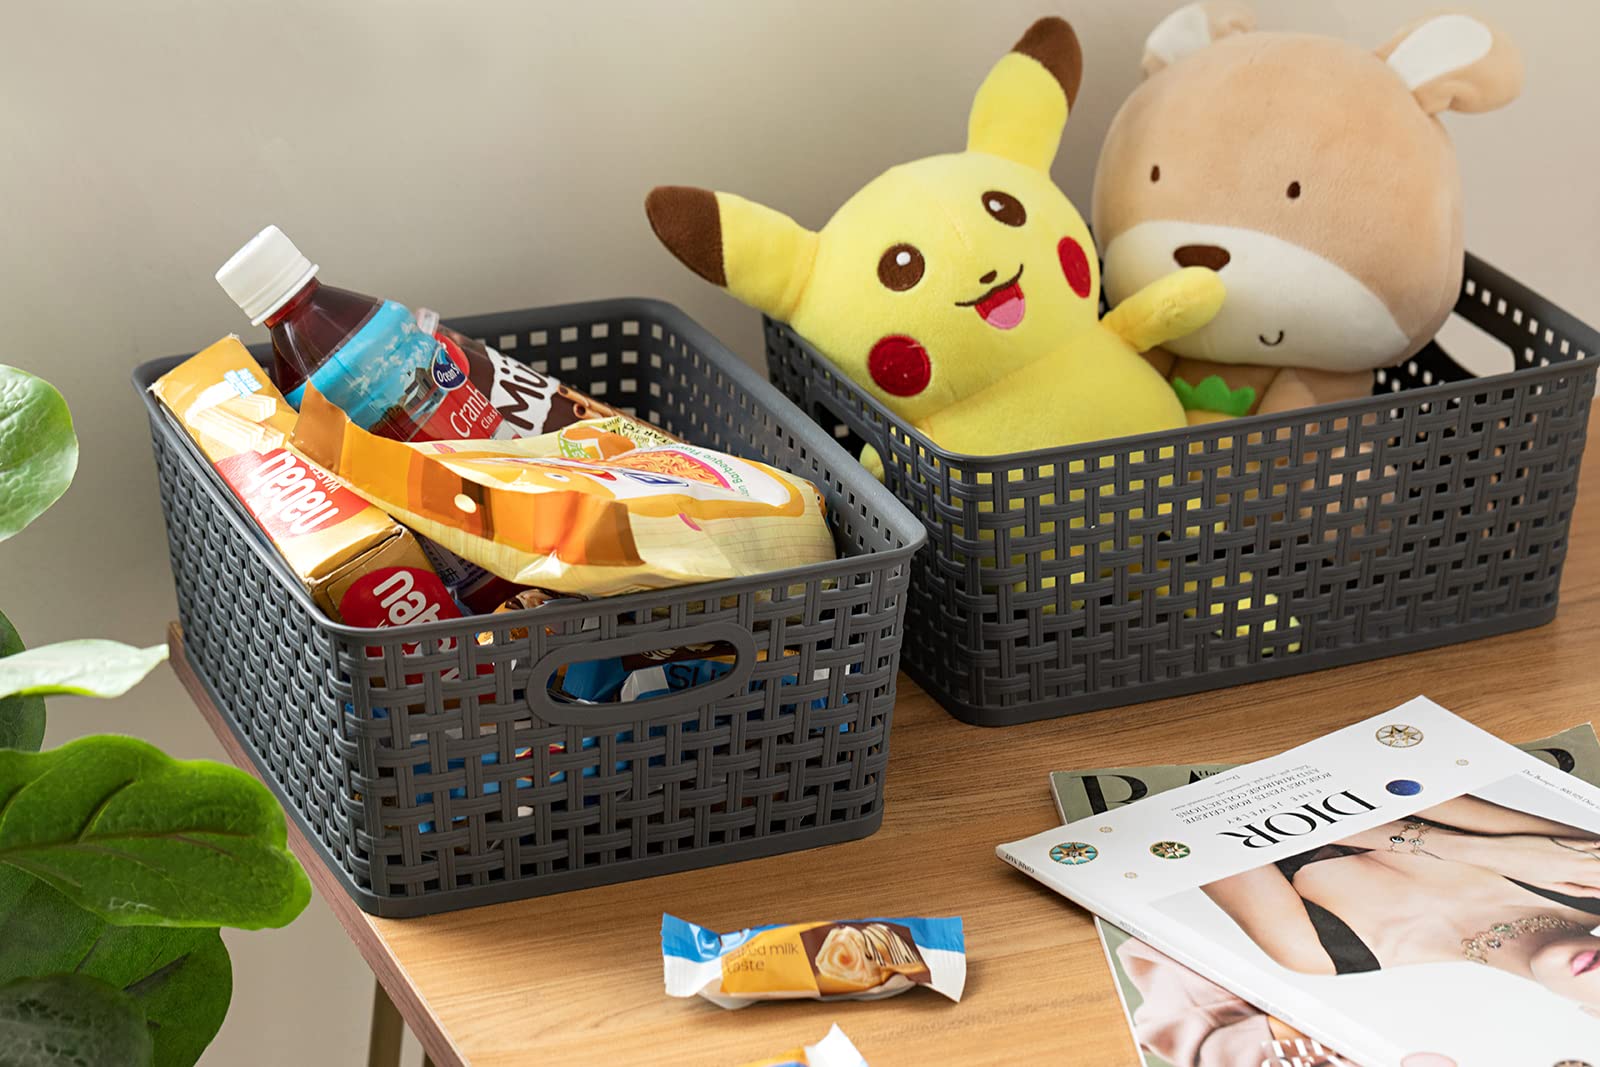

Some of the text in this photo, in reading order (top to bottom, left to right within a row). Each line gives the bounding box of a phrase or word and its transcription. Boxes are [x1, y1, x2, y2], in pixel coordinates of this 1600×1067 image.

[373, 570, 440, 627] nab
[1215, 789, 1383, 849] DIOR
[769, 942, 800, 957] milk
